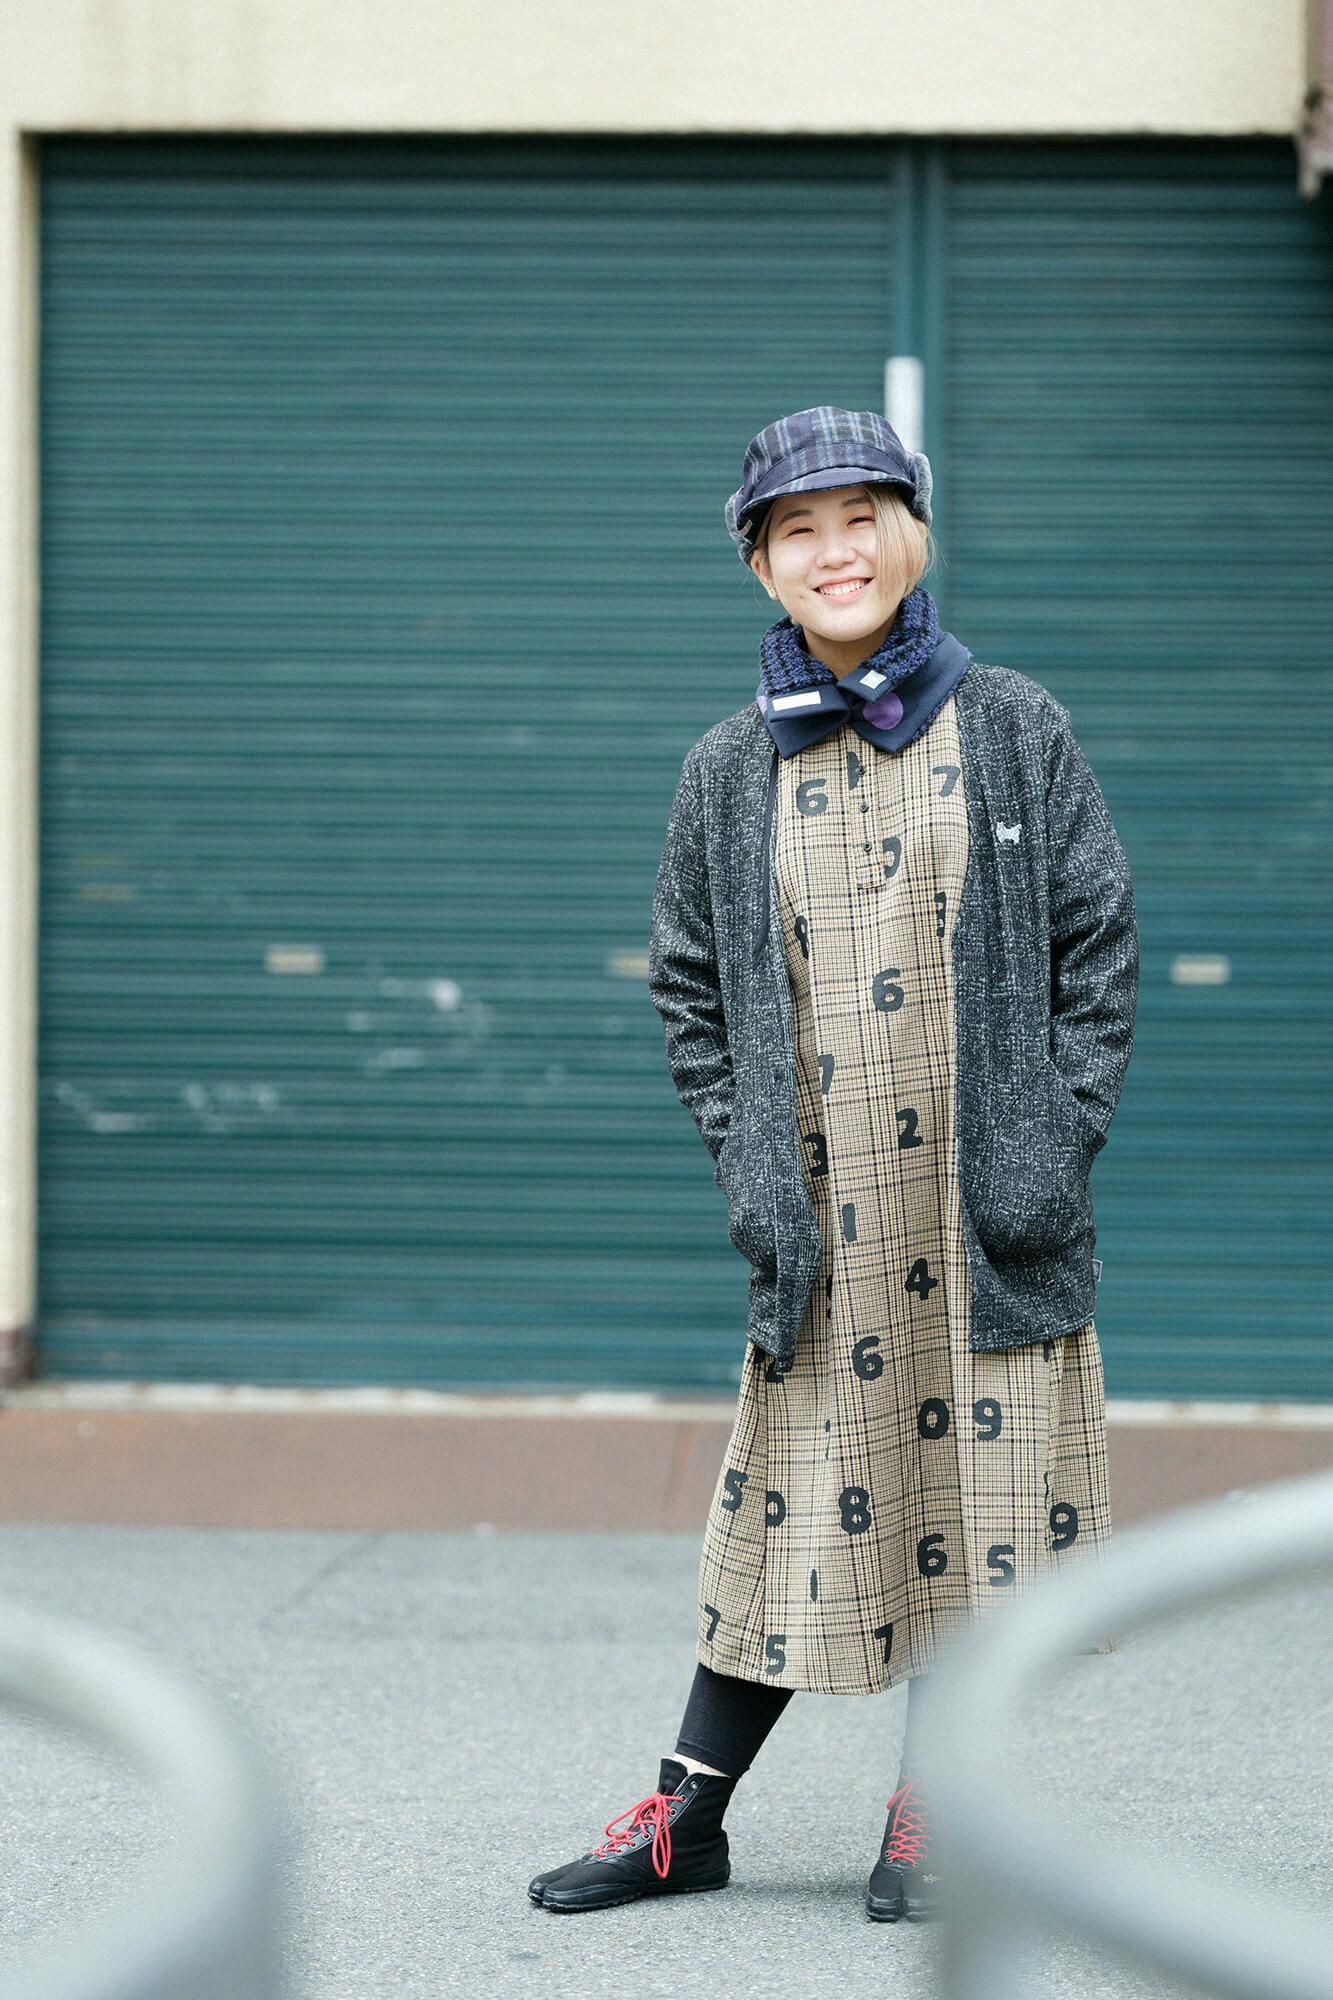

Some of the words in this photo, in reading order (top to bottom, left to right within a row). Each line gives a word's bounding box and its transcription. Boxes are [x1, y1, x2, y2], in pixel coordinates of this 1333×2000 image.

[796, 778, 828, 816] 6
[932, 765, 961, 797] 7
[872, 968, 904, 1012] 6
[896, 1108, 923, 1149] 2
[803, 1133, 829, 1177] 3
[905, 1258, 939, 1300] 4
[852, 1335, 884, 1381] 6
[917, 1397, 949, 1440] 0
[973, 1398, 1001, 1440] 9
[721, 1469, 749, 1512] 5
[838, 1486, 872, 1535] 8
[1050, 1502, 1078, 1551] 9
[917, 1533, 947, 1576] 6
[987, 1544, 1016, 1587] 5
[704, 1604, 721, 1641] 7
[874, 1623, 893, 1664] 7
[765, 1635, 786, 1676] 5
